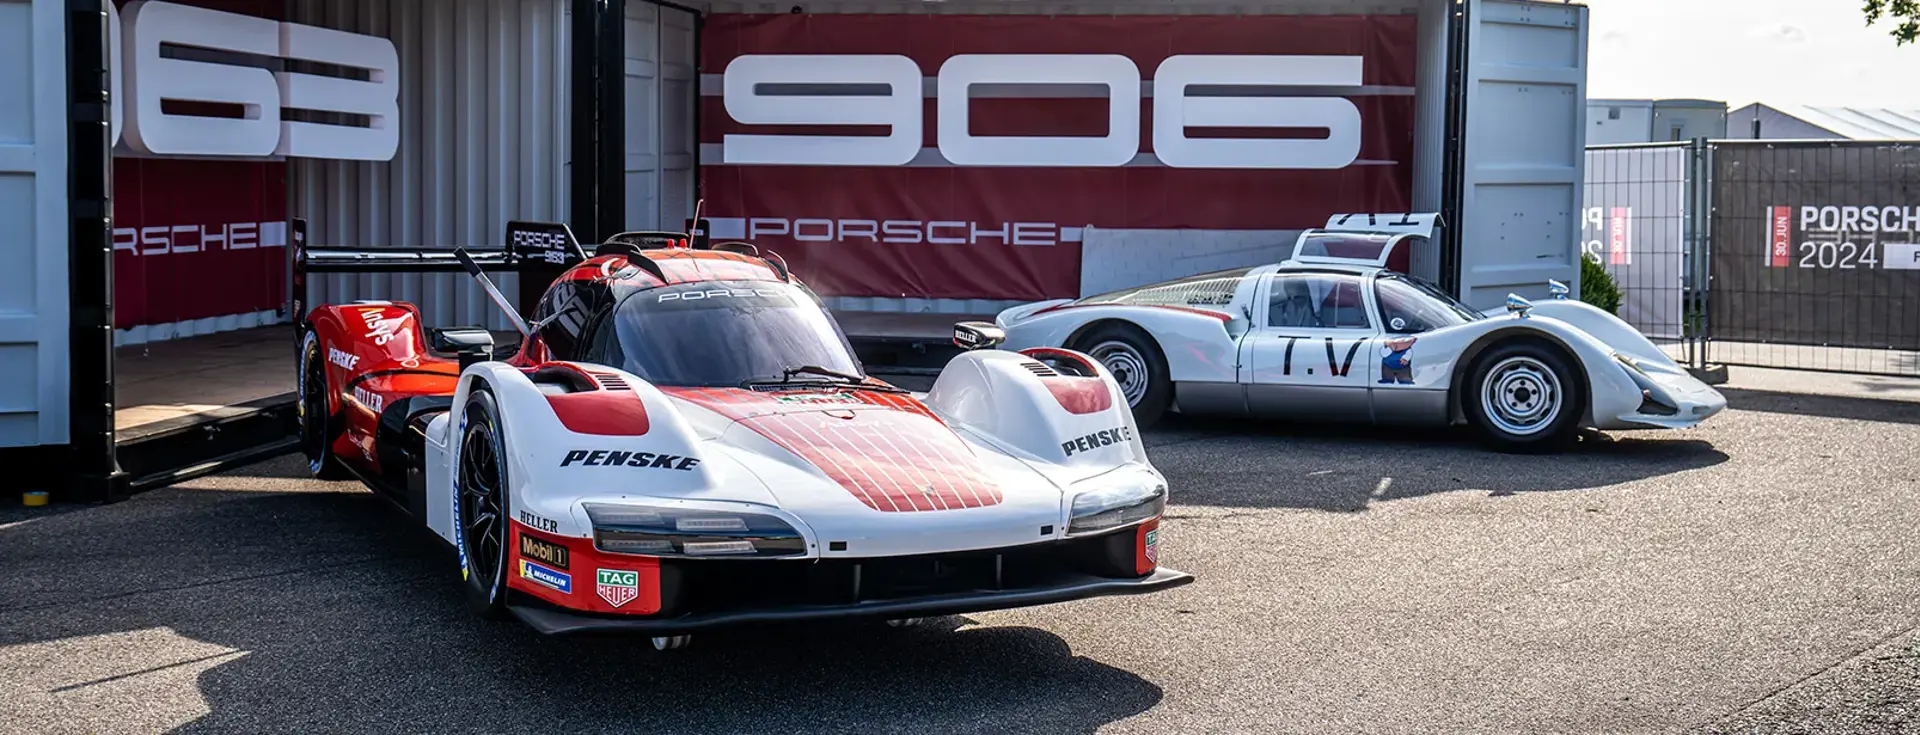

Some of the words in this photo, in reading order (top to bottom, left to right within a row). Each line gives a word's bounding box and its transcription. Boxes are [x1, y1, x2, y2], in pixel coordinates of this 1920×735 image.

[110, 0, 399, 160] 63
[723, 54, 1364, 169] 906
[1776, 216, 1787, 238] JUN
[1800, 206, 1920, 231] PORSCH
[513, 230, 565, 250] PORSCHE
[750, 218, 1056, 246] PORSCHE
[1799, 242, 1878, 269] 2024
[658, 288, 785, 303] PORSC
[329, 347, 360, 371] PENSKE
[354, 386, 383, 414] HELLER
[1061, 426, 1131, 457] PENSKE
[559, 450, 700, 471] PENSKE
[520, 510, 558, 533] HELLER
[522, 537, 552, 561] Mobil
[533, 570, 566, 587] MICHELIN
[600, 572, 634, 585] TAG
[599, 586, 636, 604] HEUER
